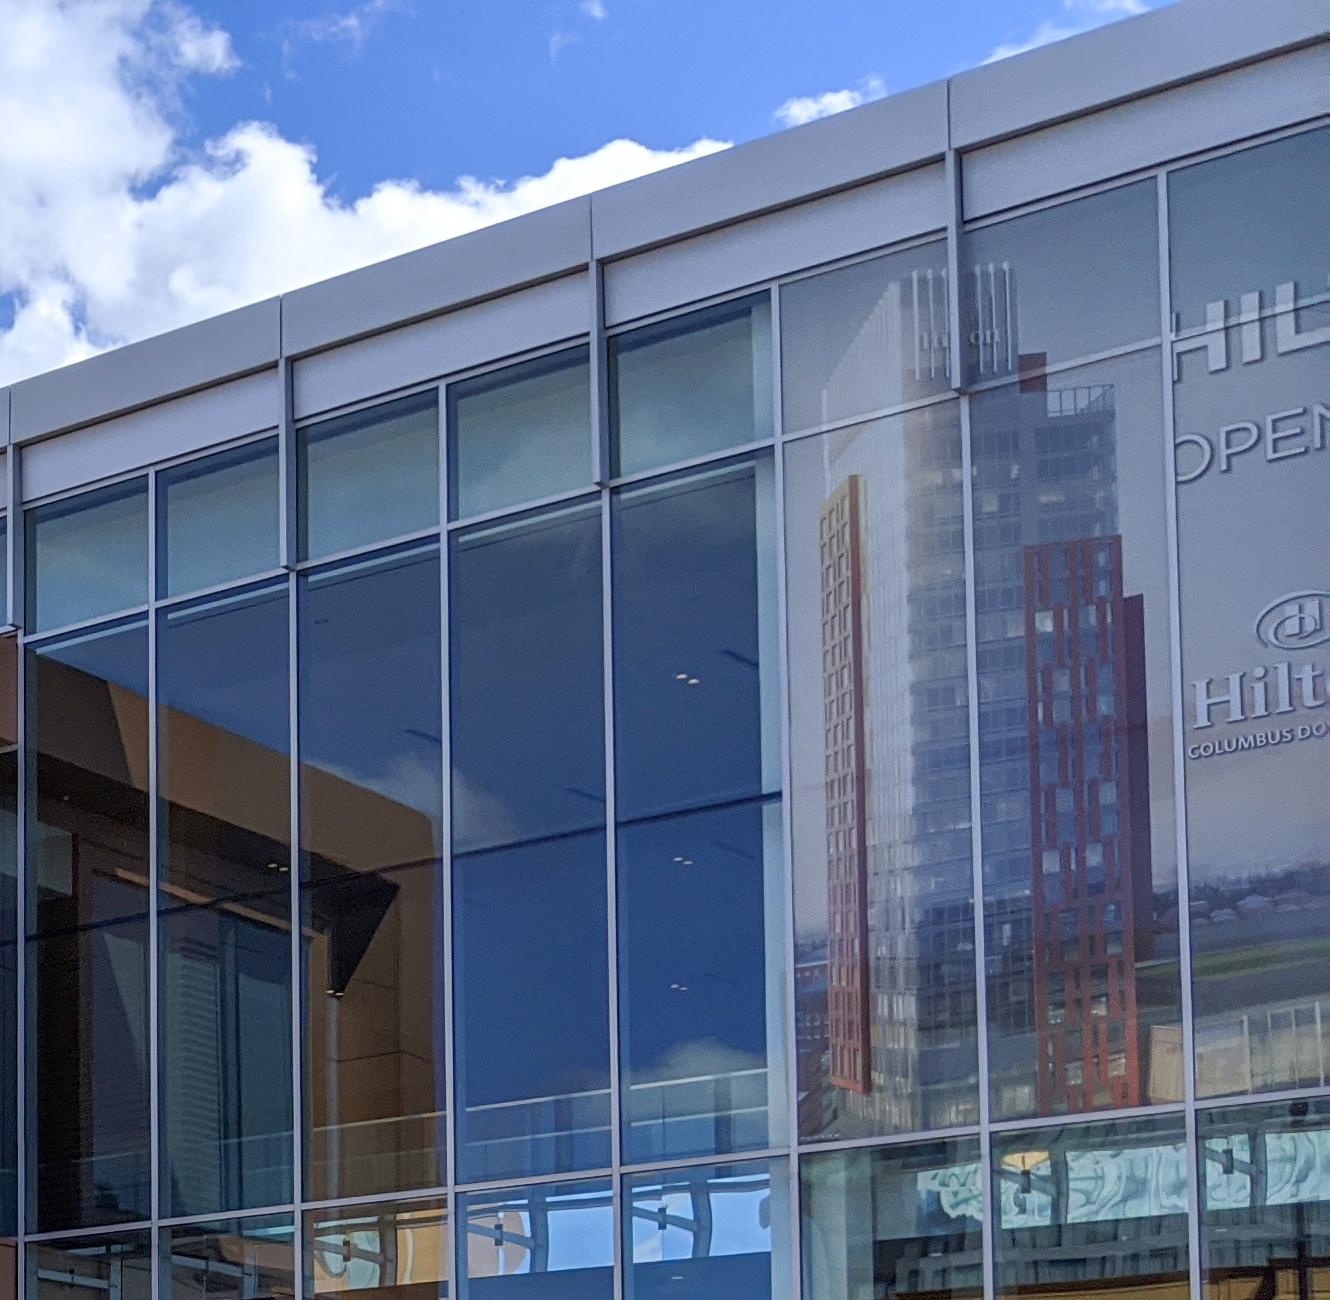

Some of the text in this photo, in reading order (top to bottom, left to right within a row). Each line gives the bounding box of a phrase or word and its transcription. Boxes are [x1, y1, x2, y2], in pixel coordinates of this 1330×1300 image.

[1172, 279, 1330, 382] HIL
[1192, 661, 1330, 729] Hilt
[1189, 720, 1330, 759] COLUMBUS DO
